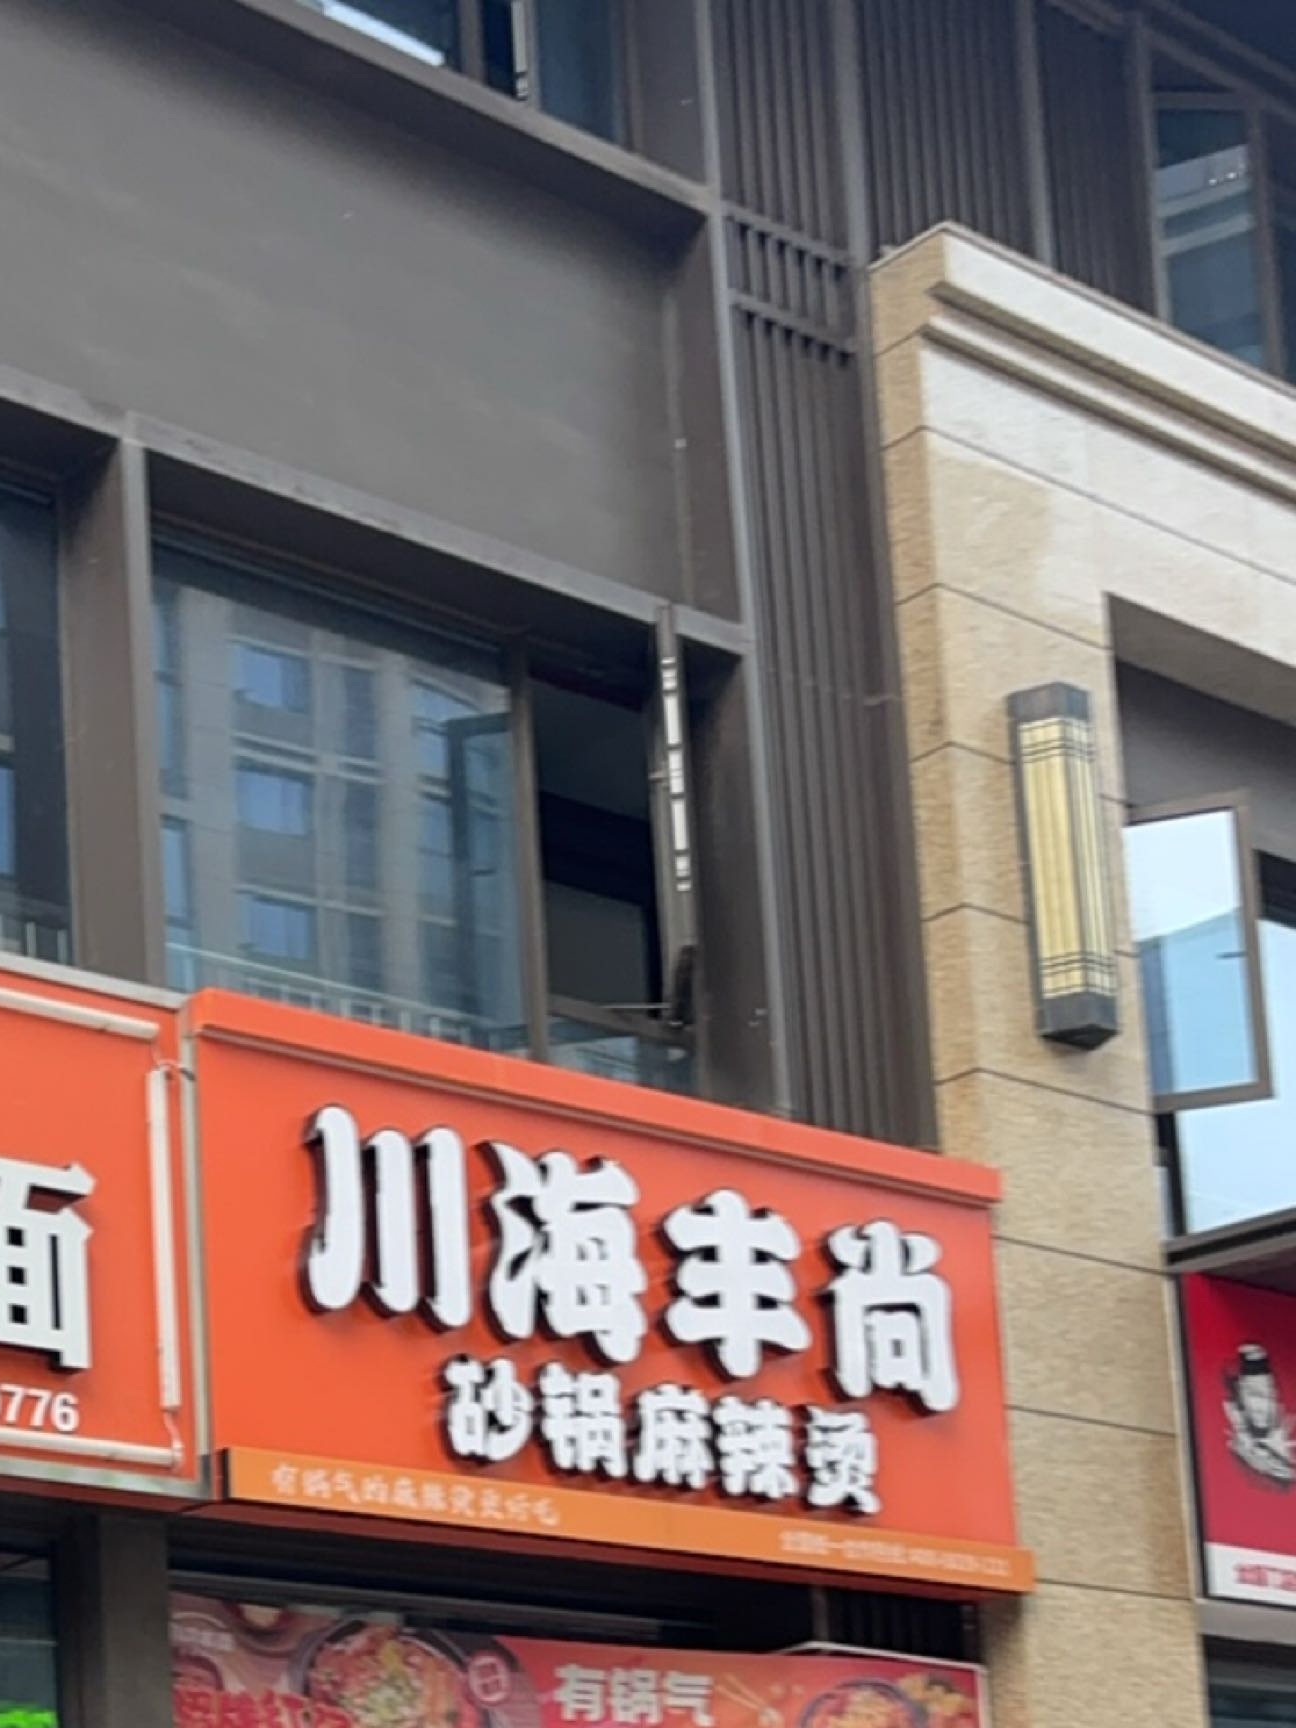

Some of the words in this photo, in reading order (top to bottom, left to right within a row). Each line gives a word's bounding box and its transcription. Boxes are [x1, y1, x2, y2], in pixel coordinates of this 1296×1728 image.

[304, 1103, 960, 1415] 川海丰尚
[441, 1357, 882, 1515] 砂锅麻辣烫
